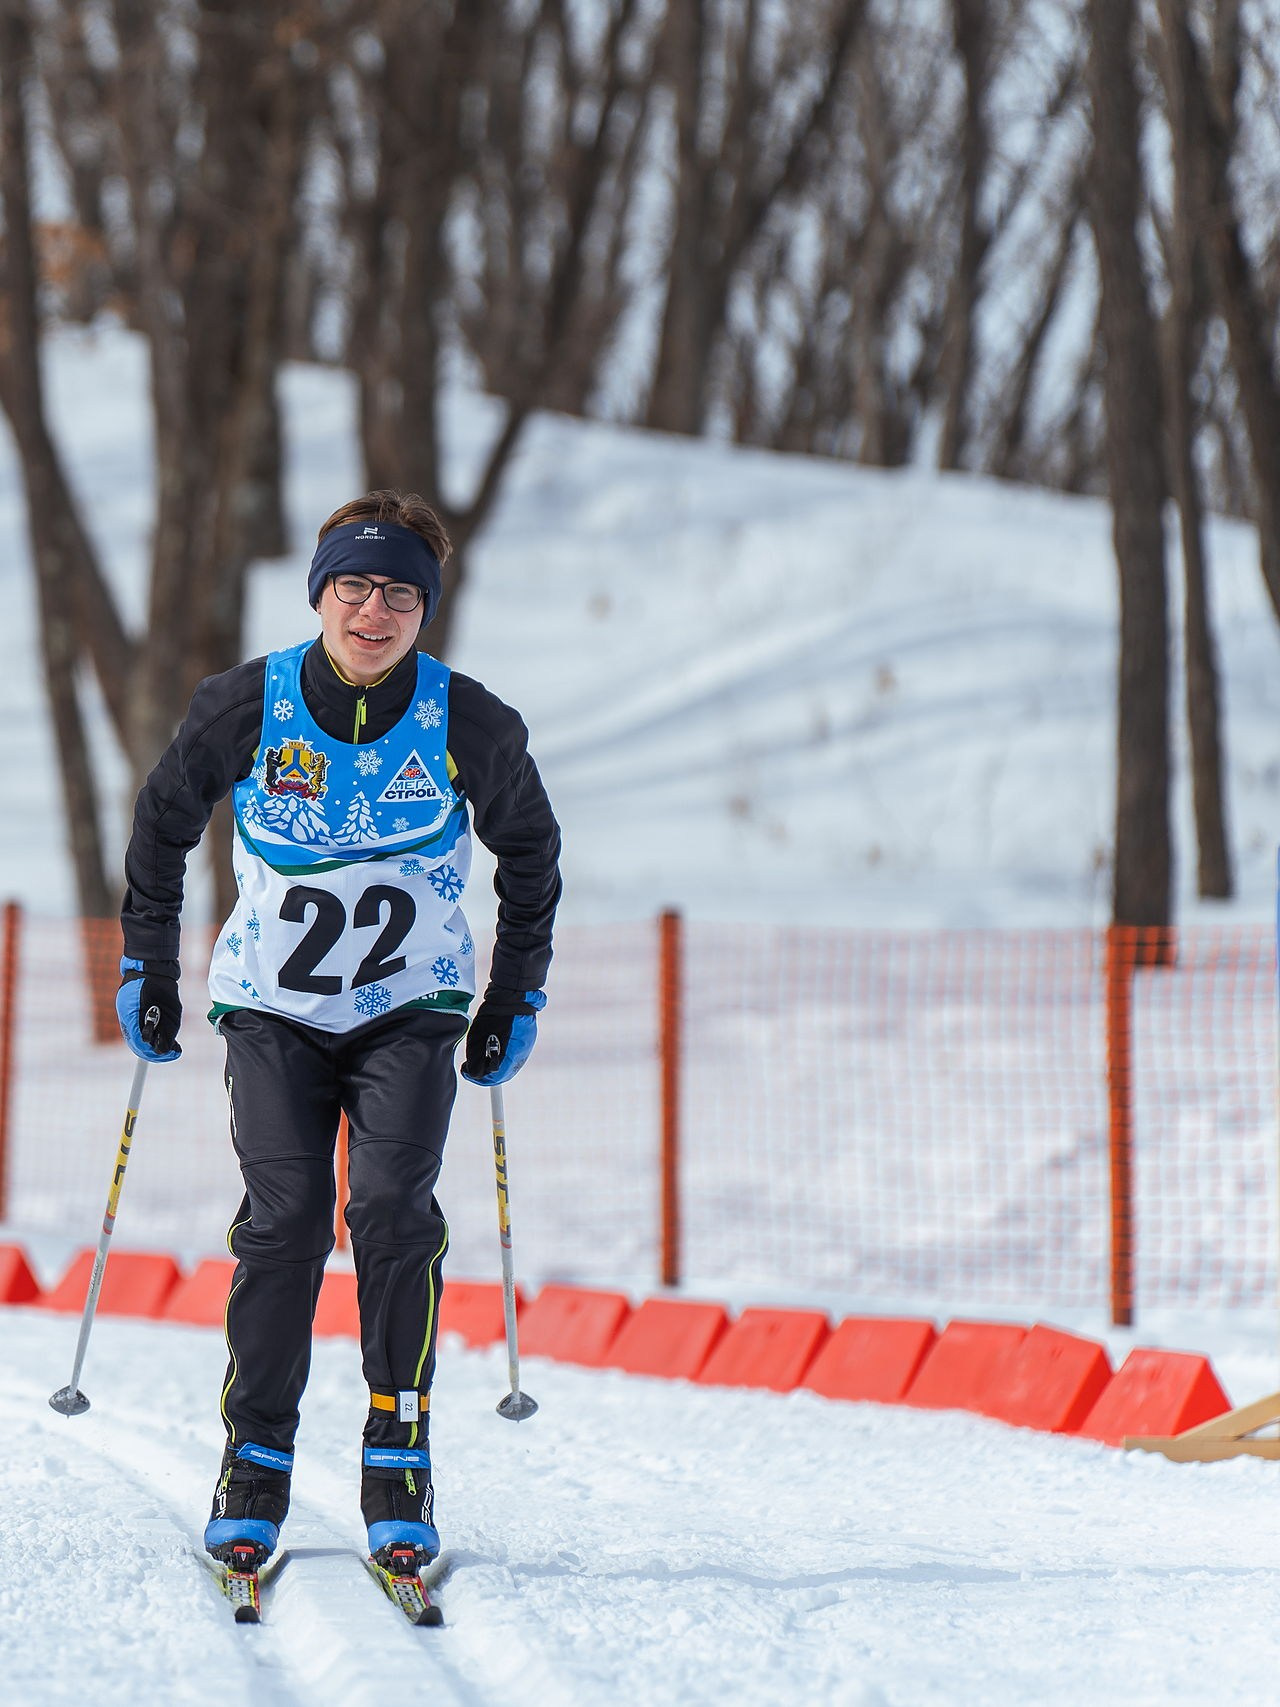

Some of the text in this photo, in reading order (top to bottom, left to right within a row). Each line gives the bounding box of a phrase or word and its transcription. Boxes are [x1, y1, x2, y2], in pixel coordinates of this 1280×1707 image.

[389, 779, 433, 790] МЕГА
[384, 788, 437, 799] СТРОЙ
[277, 884, 417, 996] 22
[404, 1402, 413, 1413] 22
[250, 1450, 293, 1466] SPINE
